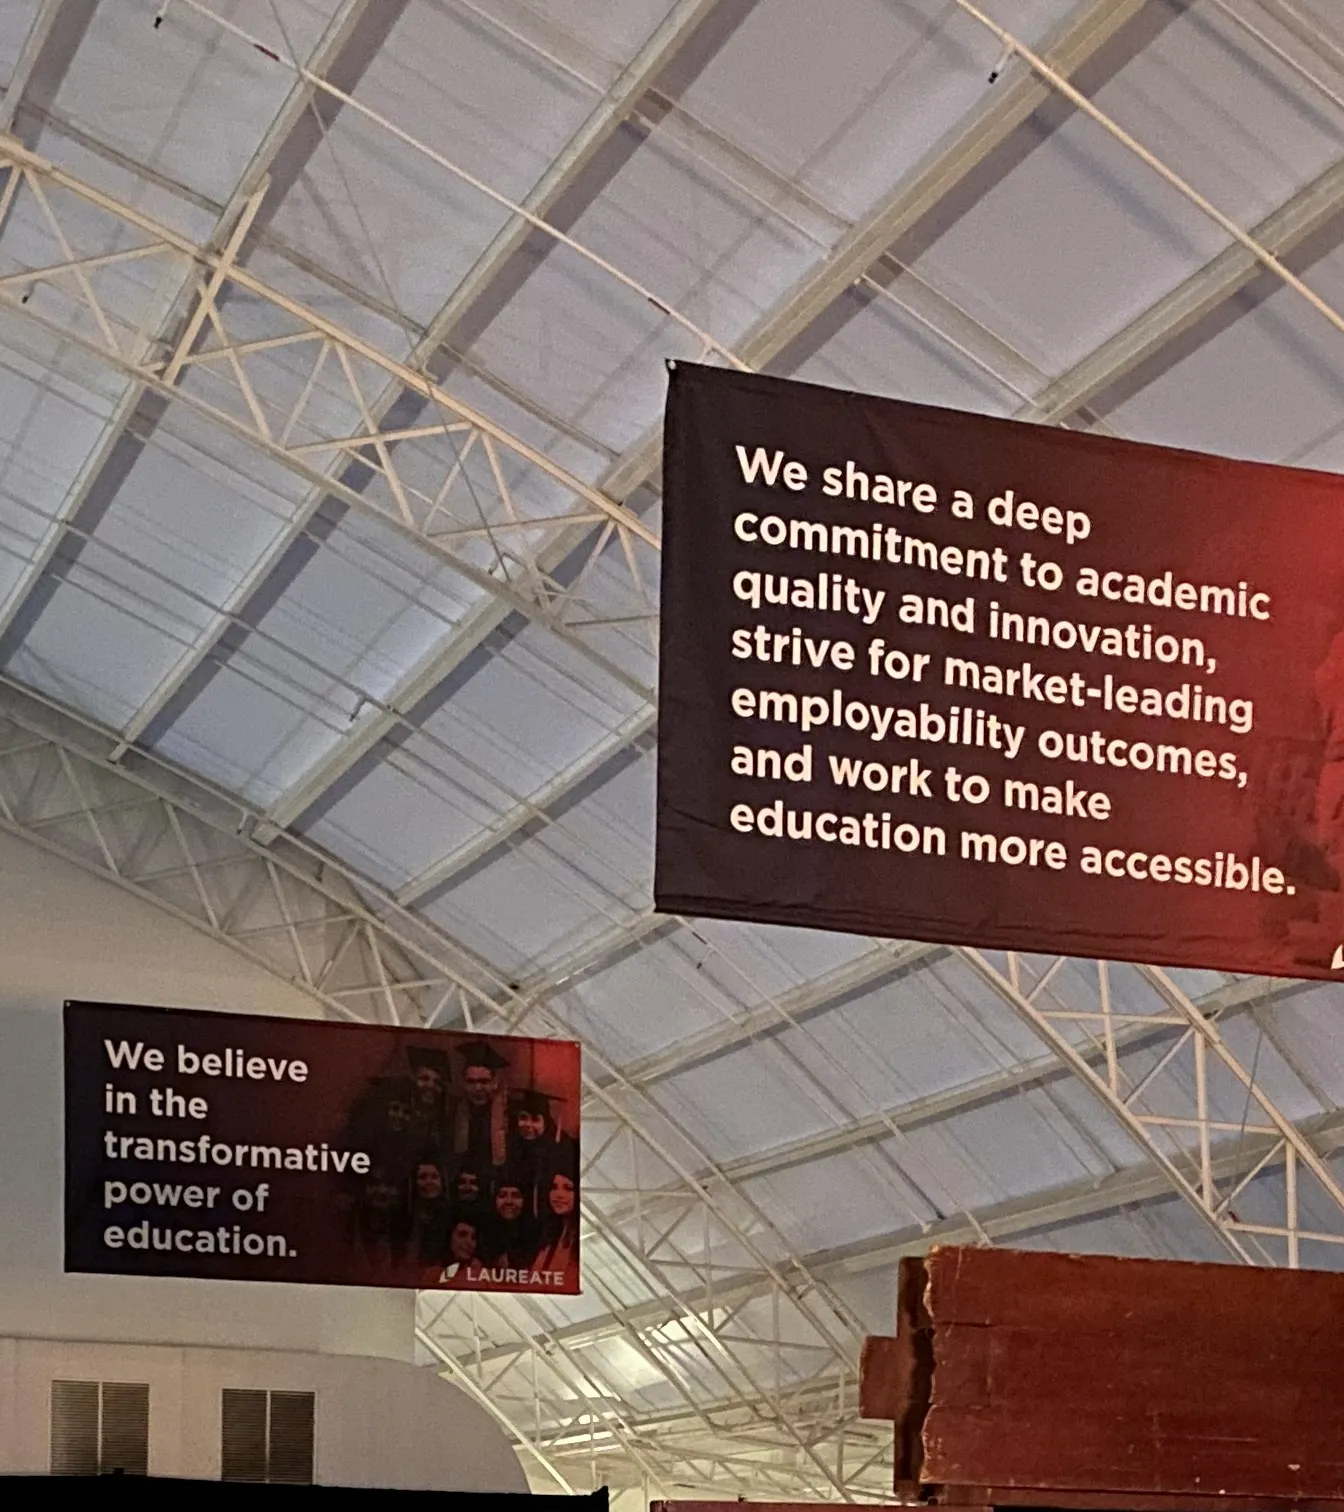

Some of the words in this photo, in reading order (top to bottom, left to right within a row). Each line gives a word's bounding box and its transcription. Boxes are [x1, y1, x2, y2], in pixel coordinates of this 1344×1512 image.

[735, 445, 809, 492] We
[822, 460, 938, 514] share
[951, 490, 975, 521] a
[987, 490, 1092, 546] deep
[734, 512, 1009, 583] commitment
[1020, 553, 1065, 592] to
[1077, 567, 1271, 621] academic
[733, 570, 886, 626] quality
[898, 594, 976, 635] and
[988, 603, 1217, 674] innovation,
[731, 625, 856, 672] strive
[868, 639, 932, 683] for
[945, 656, 1254, 735] market-leading
[731, 688, 1027, 760] employability
[1038, 731, 1249, 789] outcomes,
[731, 744, 814, 783] and
[828, 756, 933, 799] work
[945, 767, 991, 805] to
[1004, 778, 1113, 821] make
[730, 801, 947, 857] education
[961, 832, 1068, 871] more
[1080, 846, 1298, 896] accessible.
[103, 1039, 166, 1073] We
[177, 1043, 310, 1084] believe
[105, 1083, 138, 1116] in
[149, 1087, 210, 1121] the
[103, 1130, 372, 1175] transformative
[104, 1181, 222, 1210] power
[231, 1183, 271, 1213] of
[103, 1220, 298, 1258] education.
[466, 1267, 565, 1287] LAUREATE
